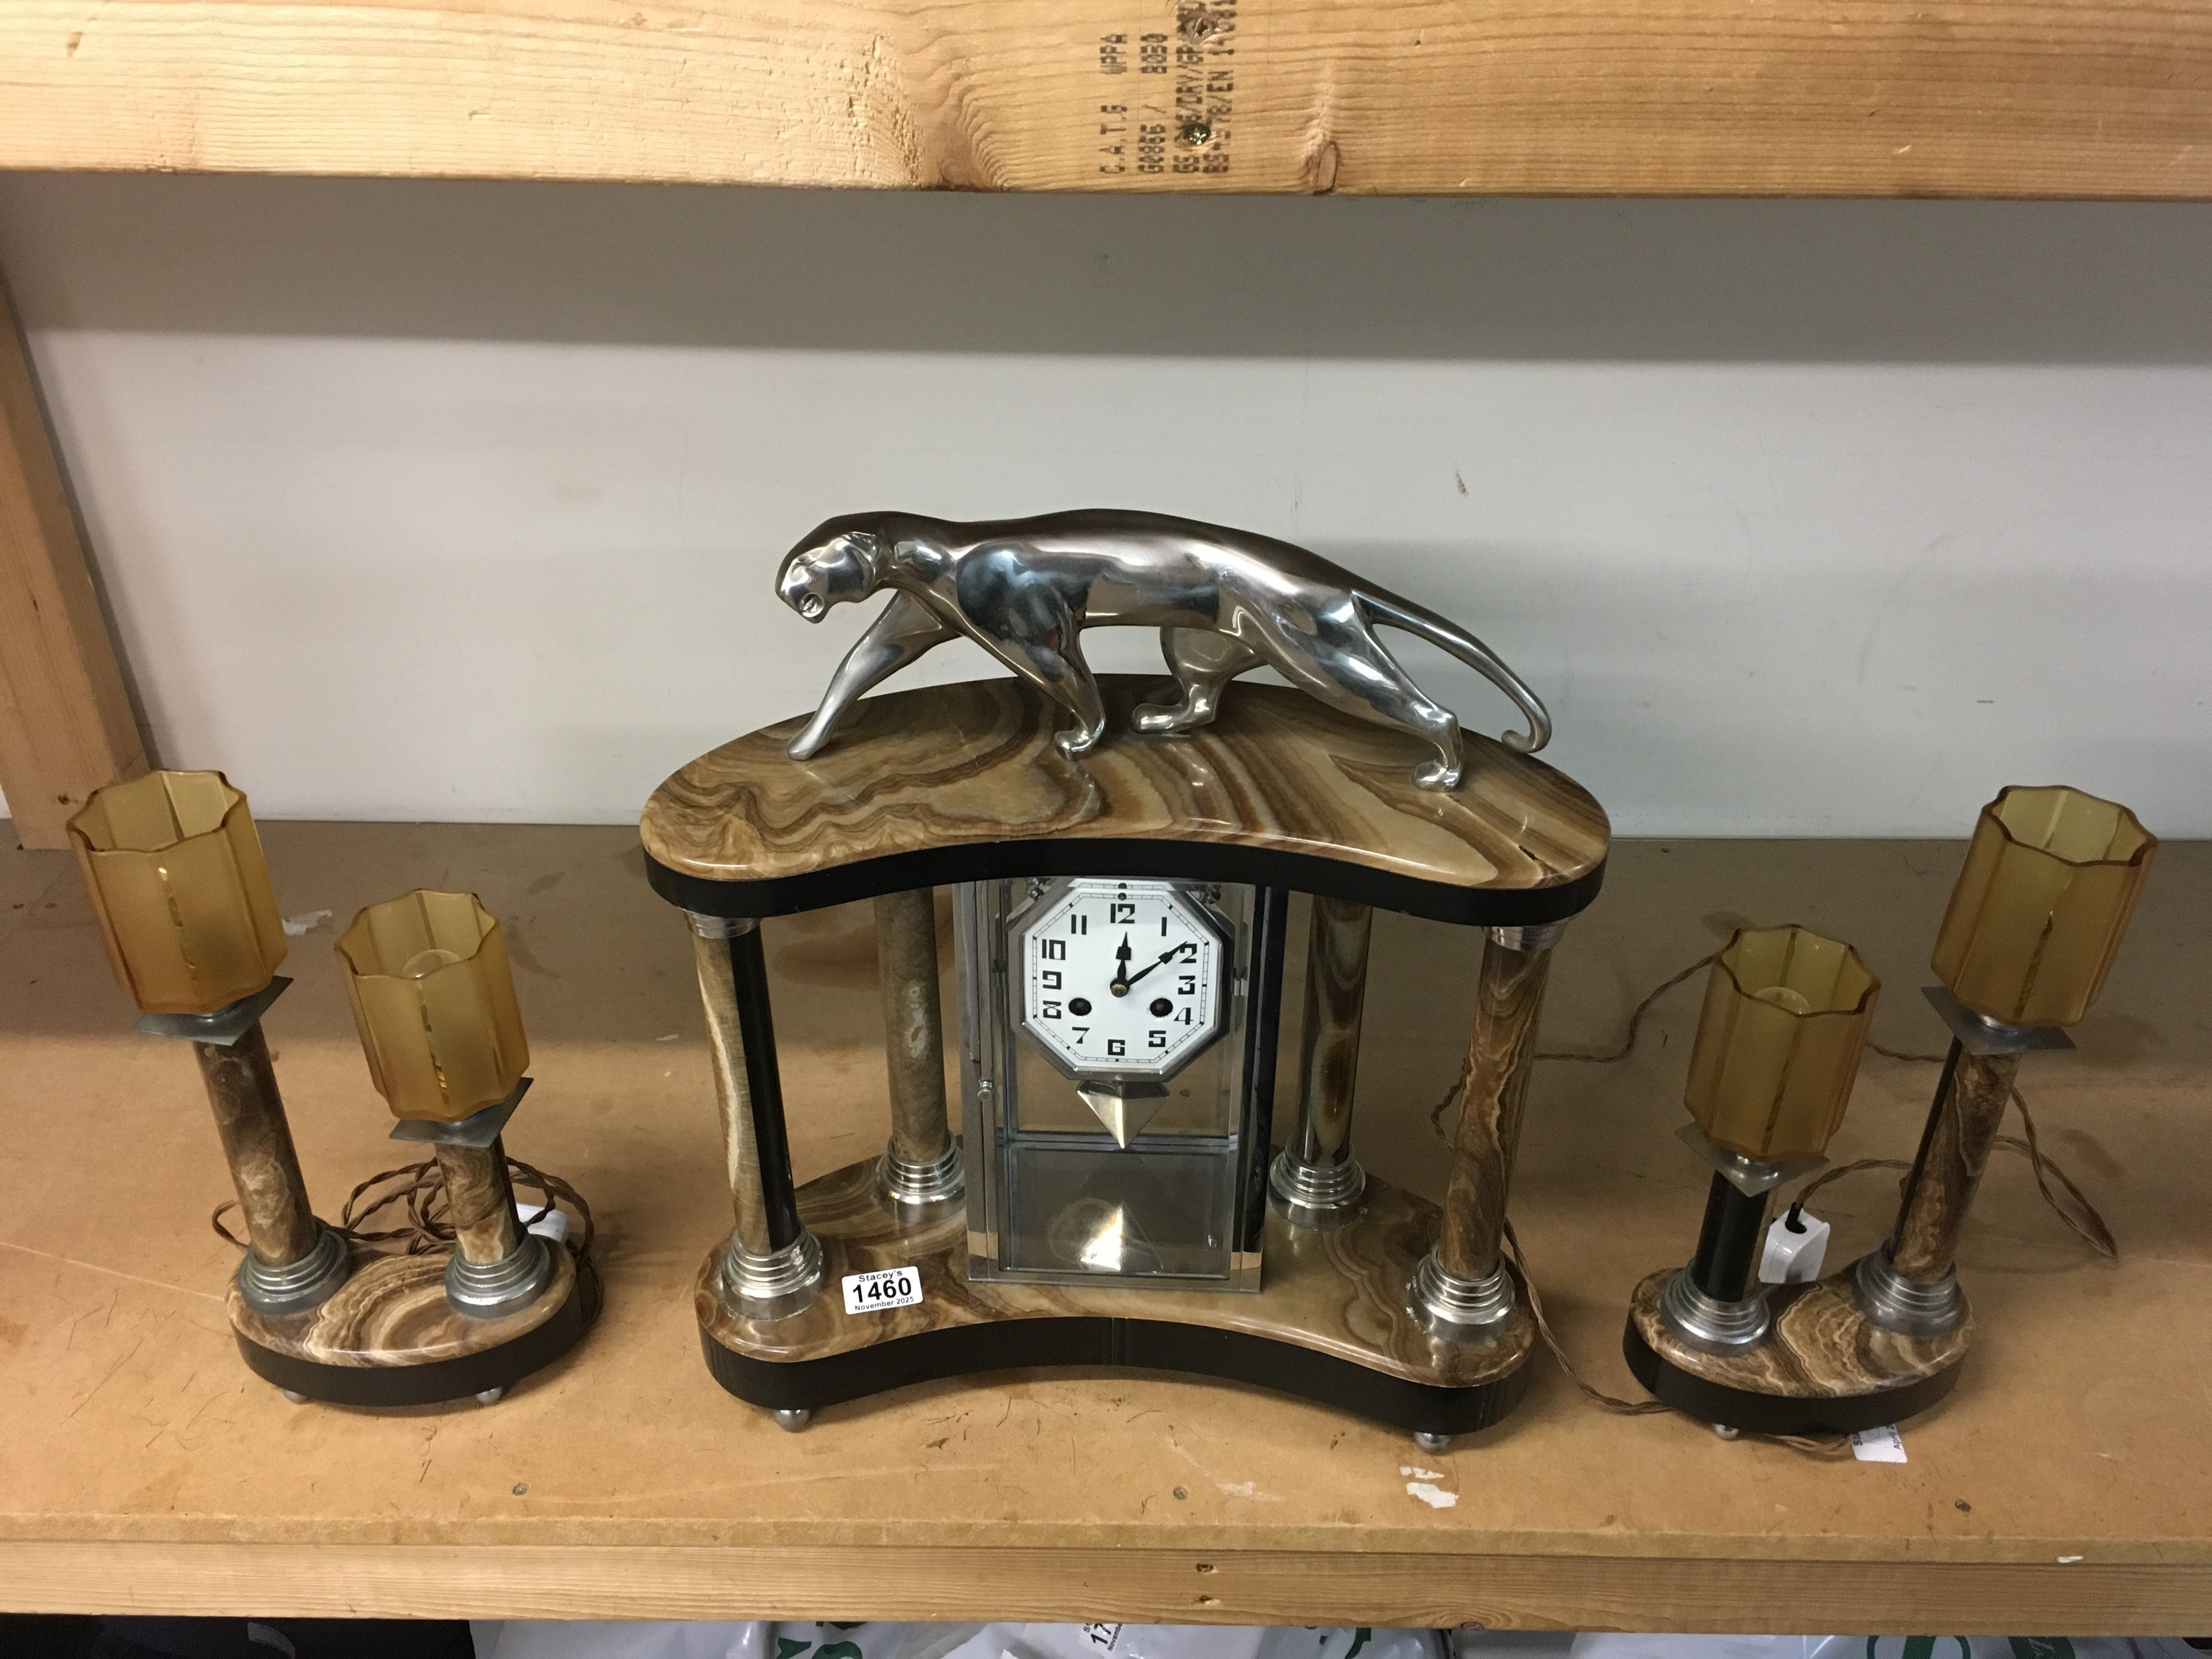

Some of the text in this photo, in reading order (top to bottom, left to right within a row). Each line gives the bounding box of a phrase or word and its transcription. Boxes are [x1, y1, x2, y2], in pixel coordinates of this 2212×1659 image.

[1110, 903, 1135, 924] 12
[1070, 914, 1087, 935] 11
[1161, 917, 1167, 936] 1
[1041, 938, 1066, 961] 10
[1178, 943, 1198, 964] 2
[1042, 970, 1062, 990] 9
[1177, 975, 1196, 995] 3
[1043, 1000, 1062, 1019] 8
[1173, 1007, 1194, 1025] 4
[1071, 1026, 1091, 1044] 7
[1148, 1030, 1167, 1048] 5
[1107, 1039, 1126, 1056] 6
[859, 1269, 902, 1282] Stacey's
[853, 1277, 911, 1303] 1460
[855, 1296, 915, 1311] November 2025
